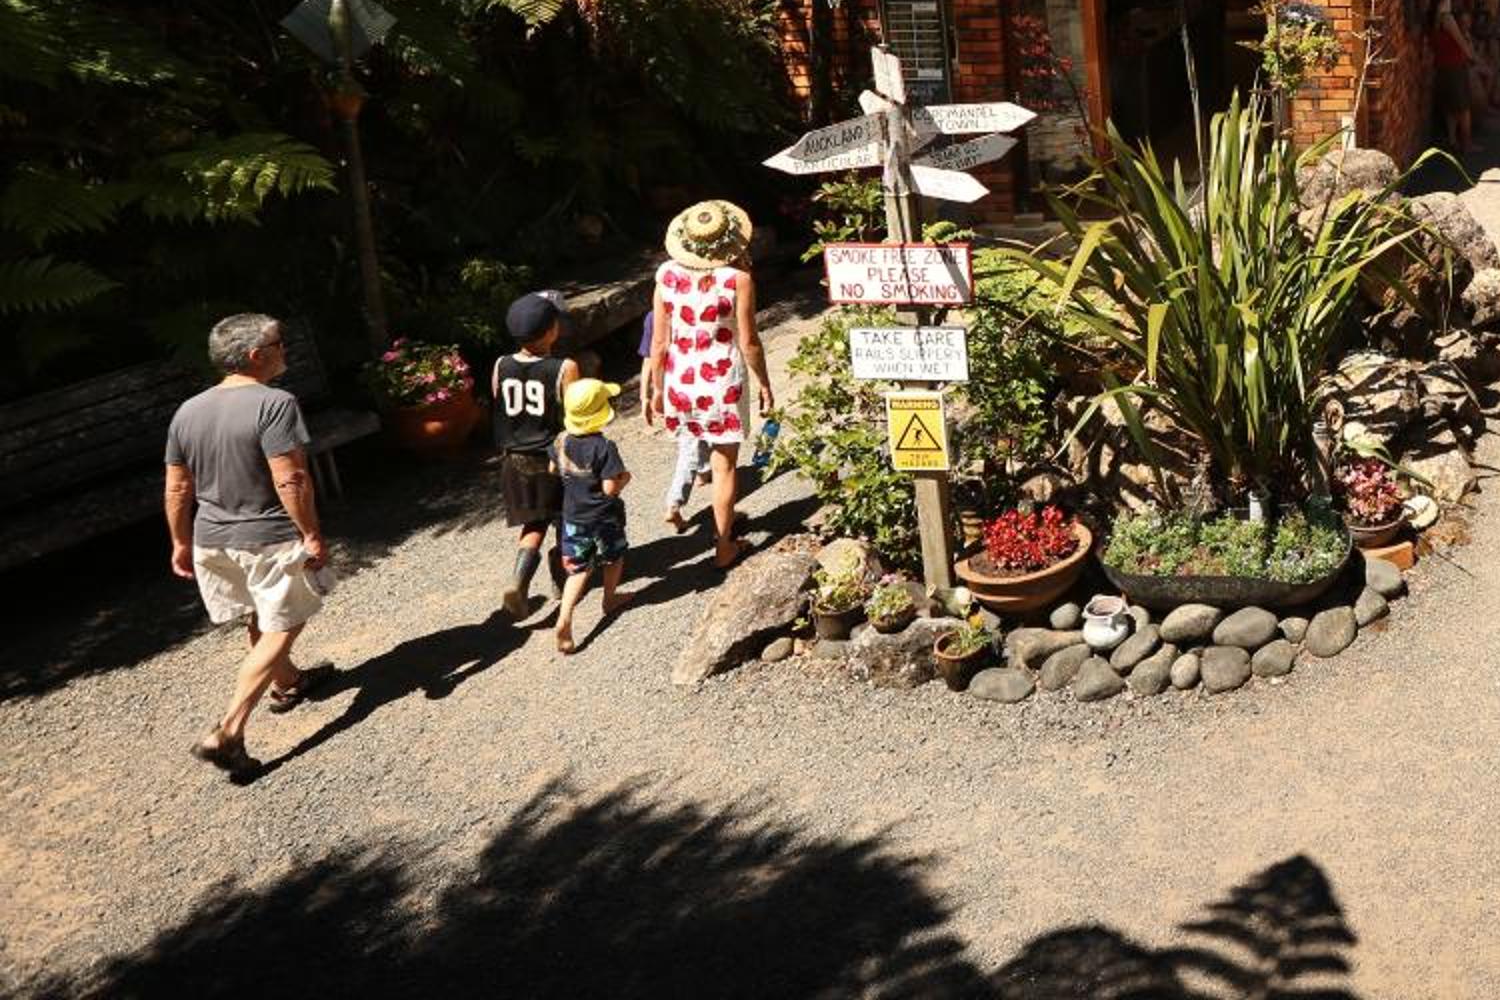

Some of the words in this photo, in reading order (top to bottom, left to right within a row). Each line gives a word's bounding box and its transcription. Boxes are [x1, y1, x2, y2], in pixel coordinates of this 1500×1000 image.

[804, 125, 863, 156] AUCKLAND
[829, 249, 878, 265] SMOKE
[883, 249, 917, 265] FREE
[924, 249, 963, 265] ZONE
[867, 267, 930, 283] PLEASE
[840, 283, 865, 299] NO
[881, 283, 957, 300] SMOKING
[859, 331, 903, 345] TAKE
[913, 331, 955, 346] CARE
[855, 347, 894, 360] RAILS
[873, 362, 913, 374] WHEN
[920, 362, 950, 374] WET
[502, 378, 545, 417] 09
